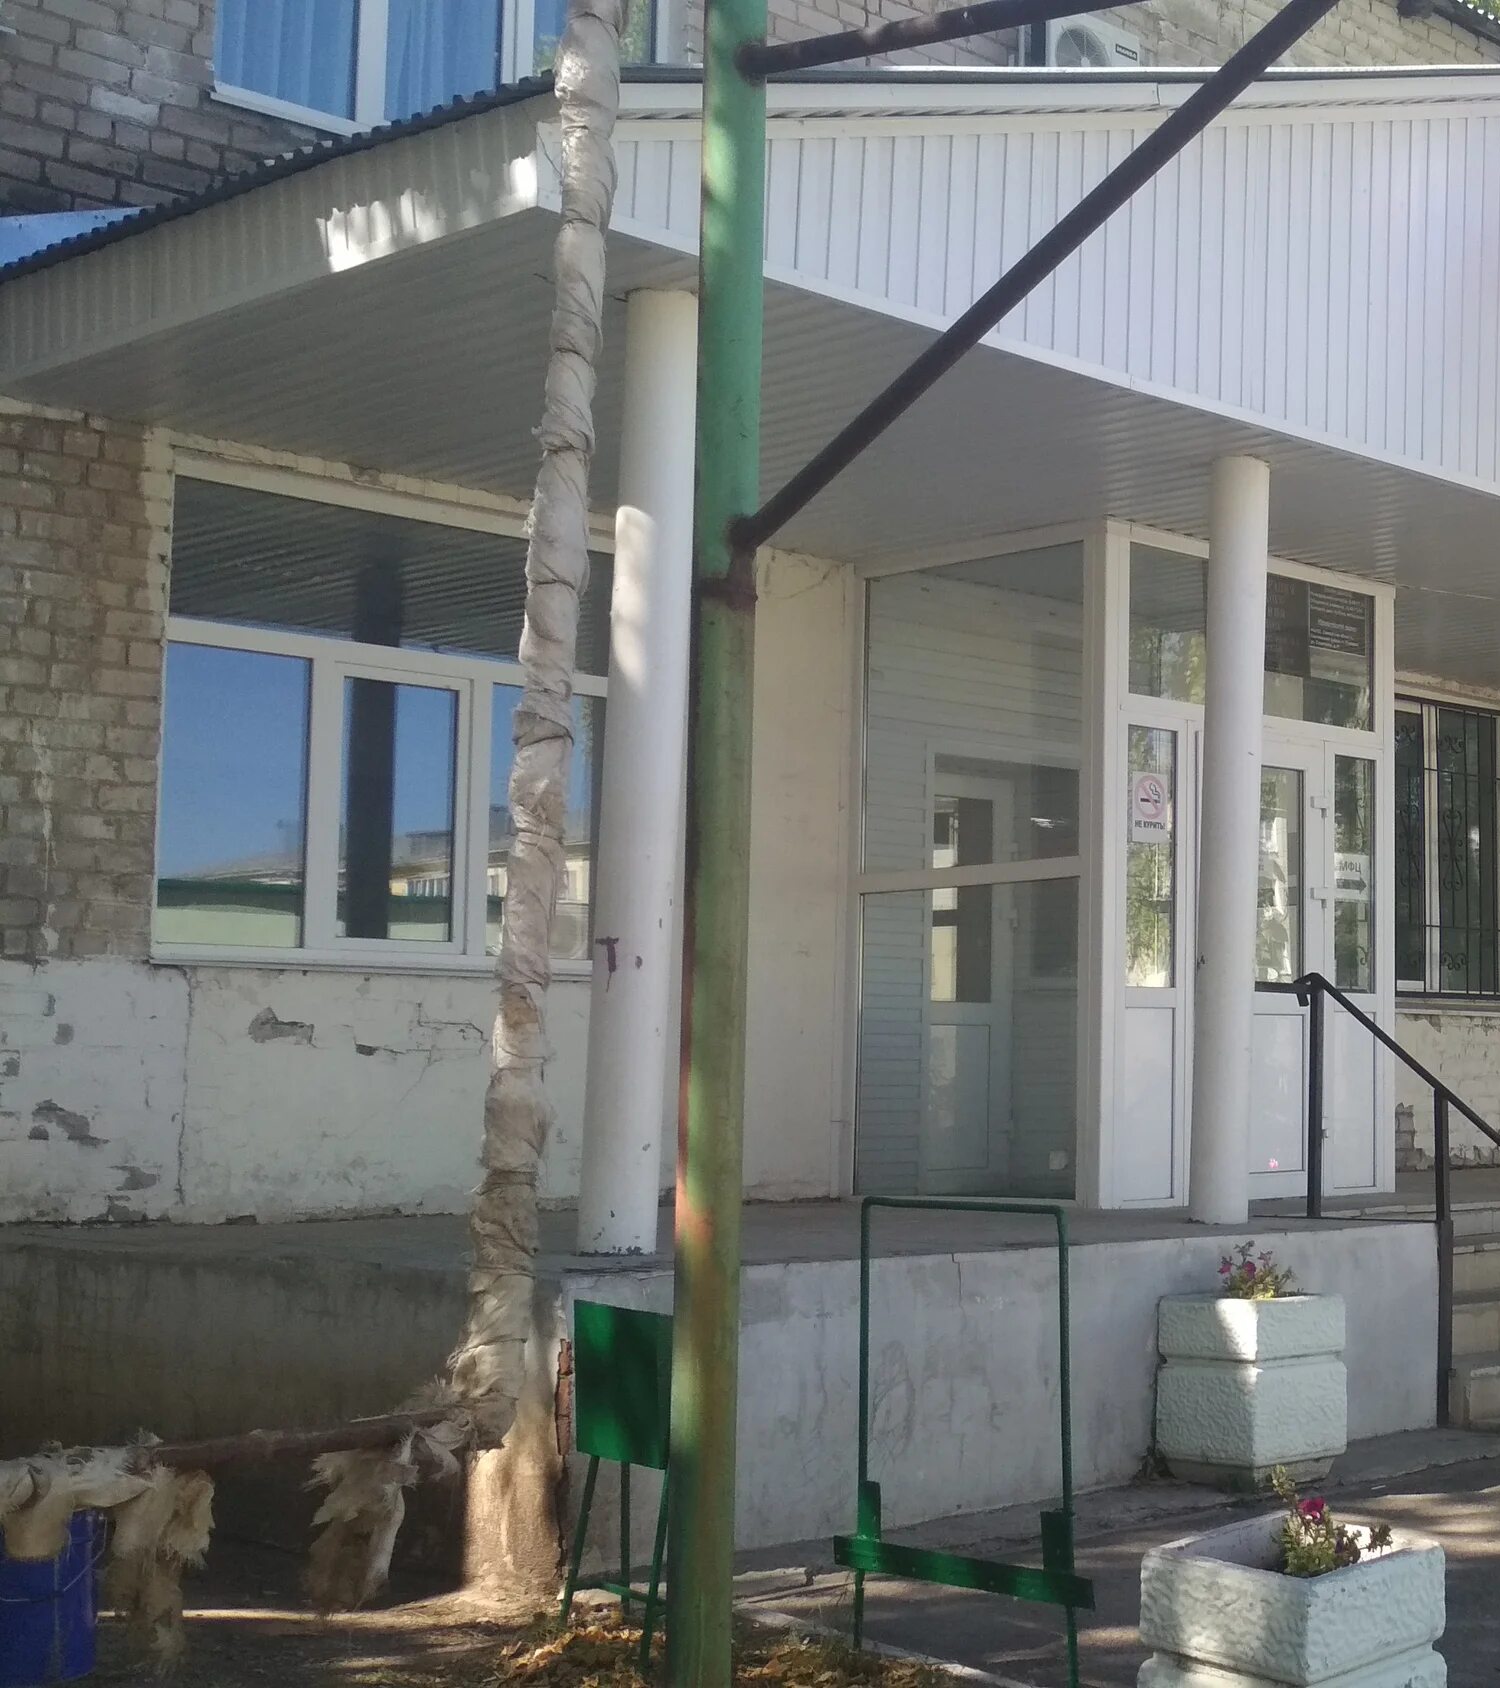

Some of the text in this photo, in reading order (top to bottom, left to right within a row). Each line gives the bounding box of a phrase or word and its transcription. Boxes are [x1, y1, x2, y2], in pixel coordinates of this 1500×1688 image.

[1134, 820, 1166, 830] НЕ КУРИТЬ!
[1339, 860, 1361, 873] МФЦ
